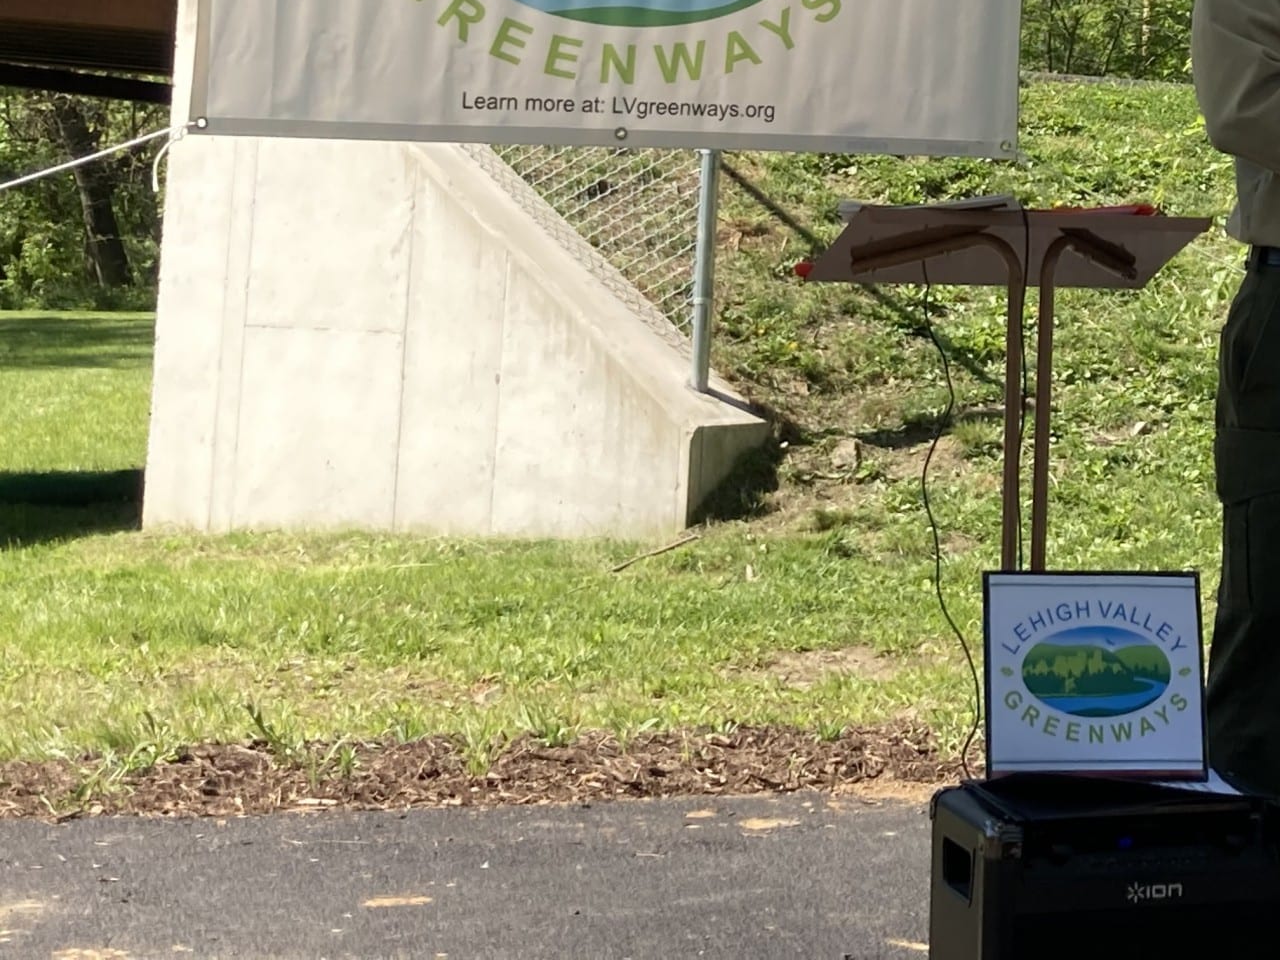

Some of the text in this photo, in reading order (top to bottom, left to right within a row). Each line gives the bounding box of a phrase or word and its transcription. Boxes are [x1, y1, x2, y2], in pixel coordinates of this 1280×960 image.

[462, 91, 776, 123] Learn more at: LVgreenways.org
[1001, 600, 1188, 656] LEHIGH VALLEY
[1003, 689, 1189, 744] GREENWAYS
